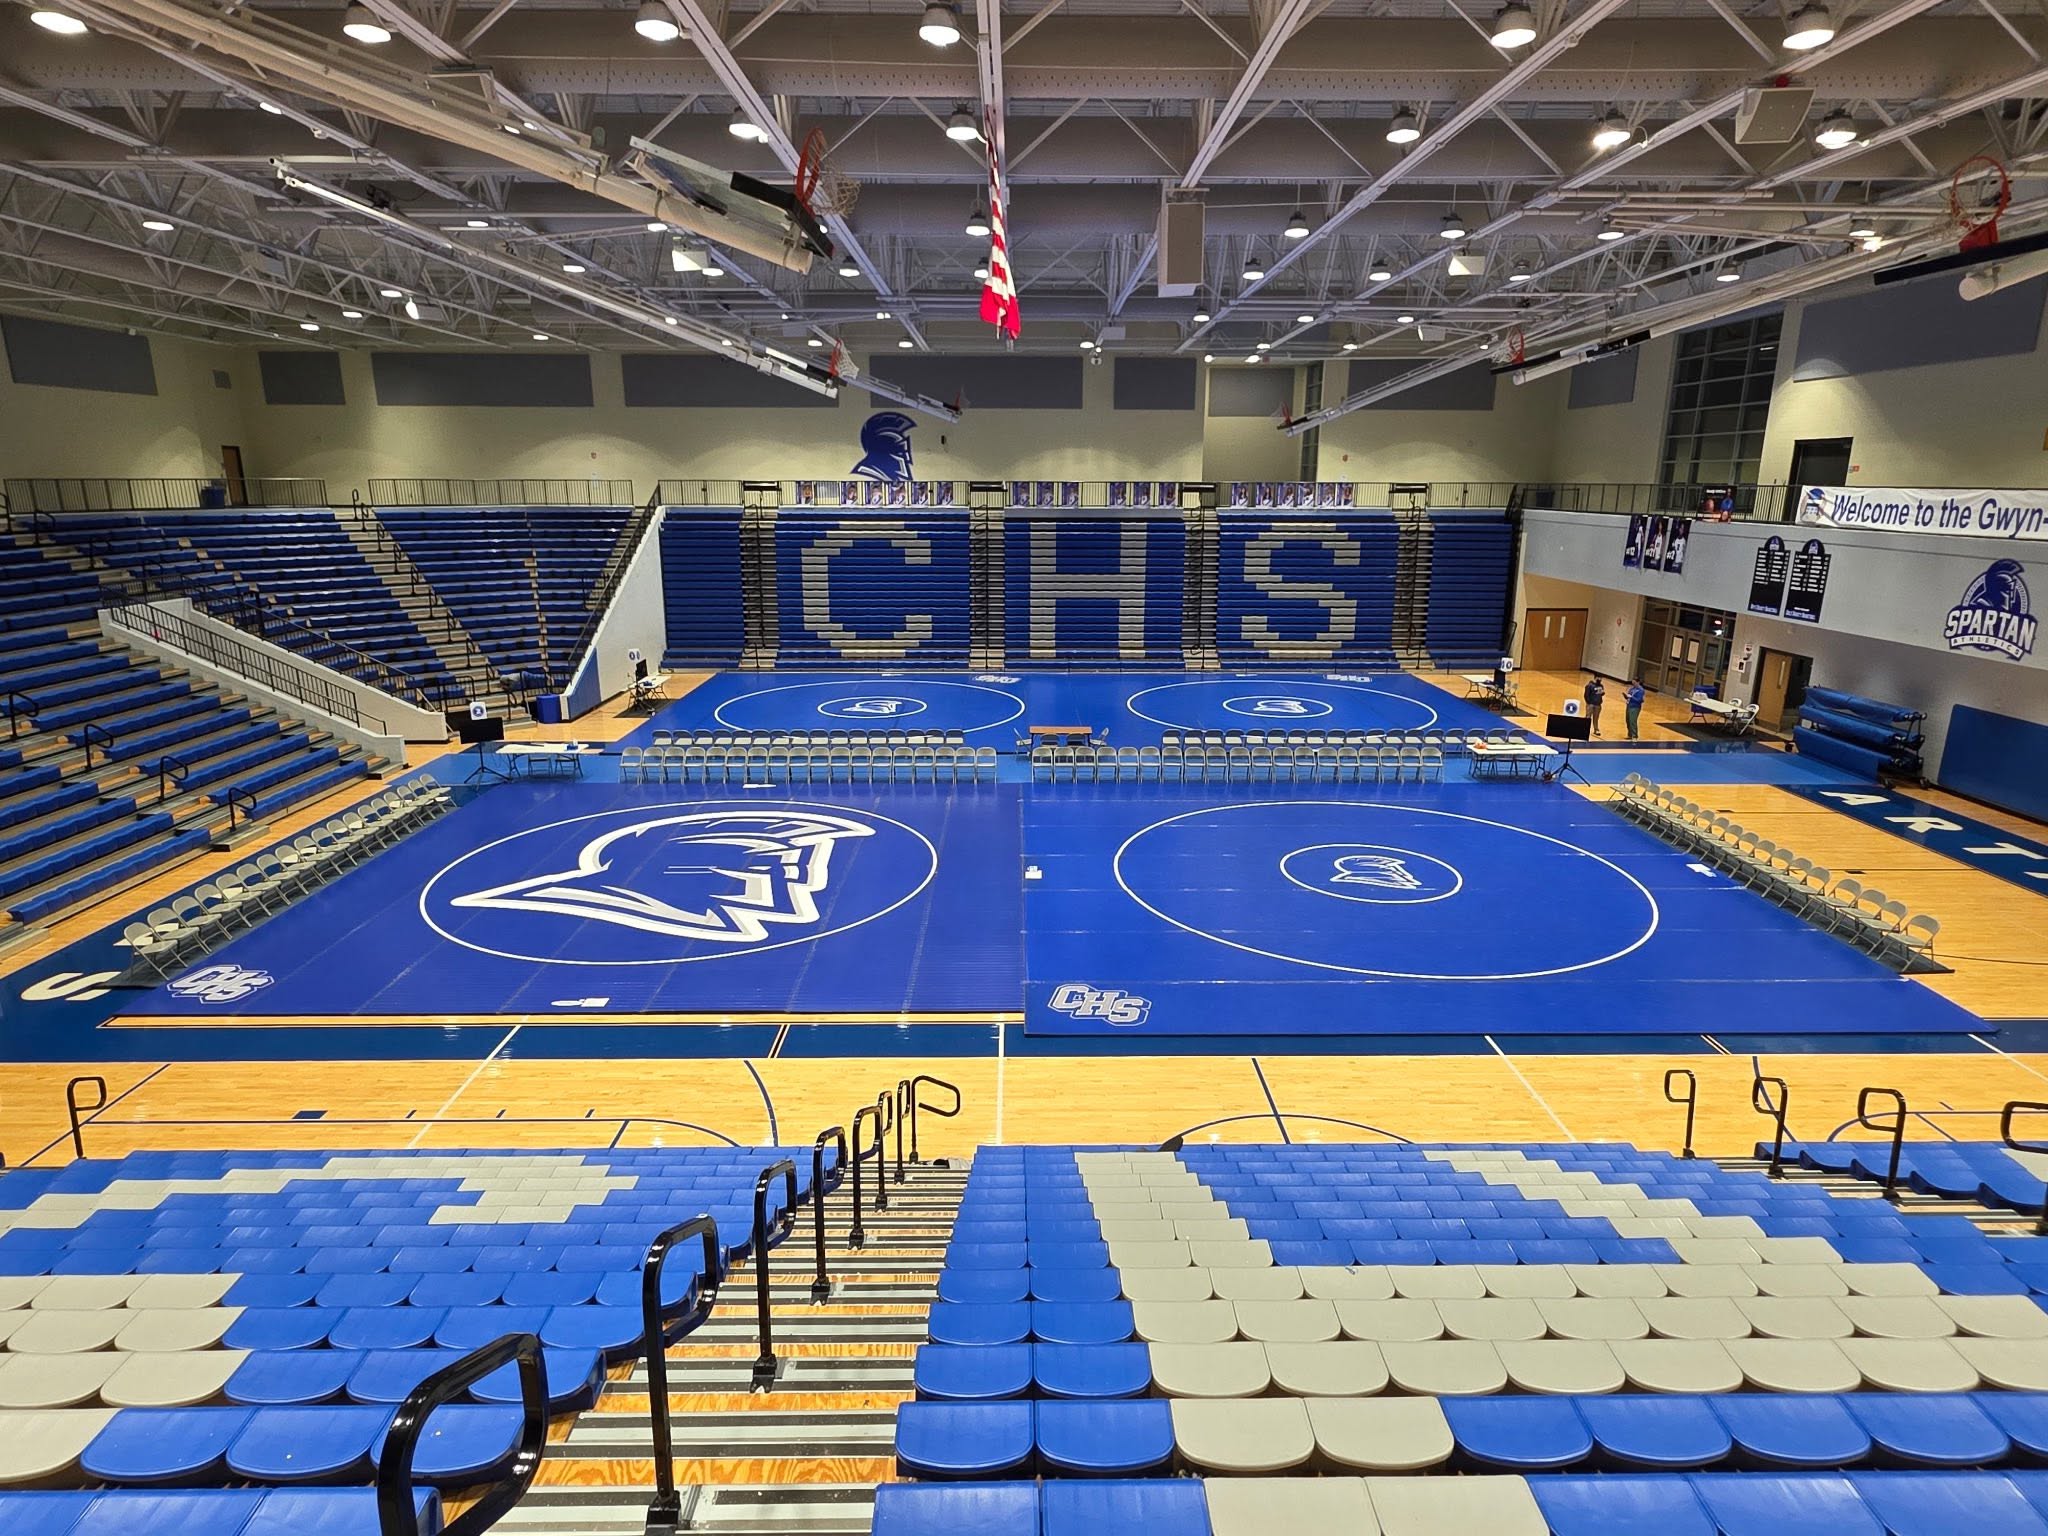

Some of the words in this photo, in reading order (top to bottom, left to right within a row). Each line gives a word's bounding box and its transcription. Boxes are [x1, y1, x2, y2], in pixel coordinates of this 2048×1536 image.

[1830, 495, 1909, 525] Welcome
[1914, 498, 1934, 526] to
[1938, 498, 1972, 529] the
[801, 521, 1360, 658] CHS
[1944, 609, 2036, 651] SPARTAN
[1952, 636, 2021, 656] ATHLETICS
[1050, 984, 1149, 1024] CHS
